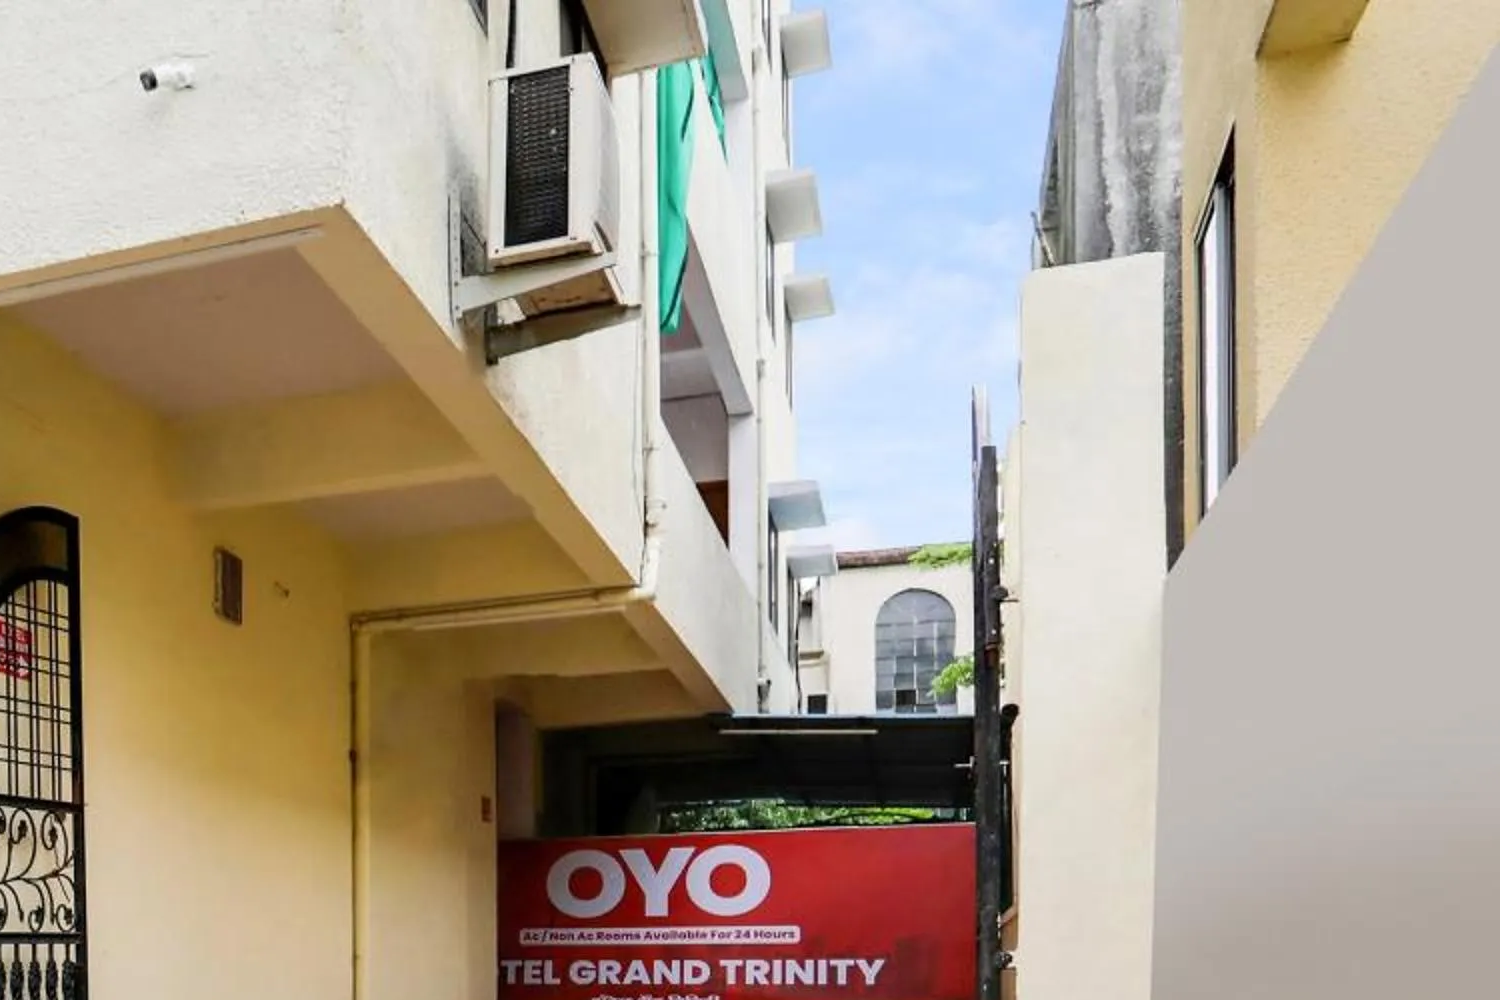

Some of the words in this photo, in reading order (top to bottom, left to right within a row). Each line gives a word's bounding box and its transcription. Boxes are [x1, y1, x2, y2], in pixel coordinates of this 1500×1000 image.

[546, 844, 771, 919] OYO
[550, 931, 575, 941] Non
[577, 931, 594, 941] Ac
[595, 931, 641, 941] Rooms
[643, 929, 709, 940] Available
[711, 929, 732, 940] For
[734, 929, 751, 940] 24
[753, 928, 796, 939] Hours
[498, 959, 561, 985] TEL
[568, 958, 711, 986] GRAND
[718, 958, 886, 986] TRINITY
